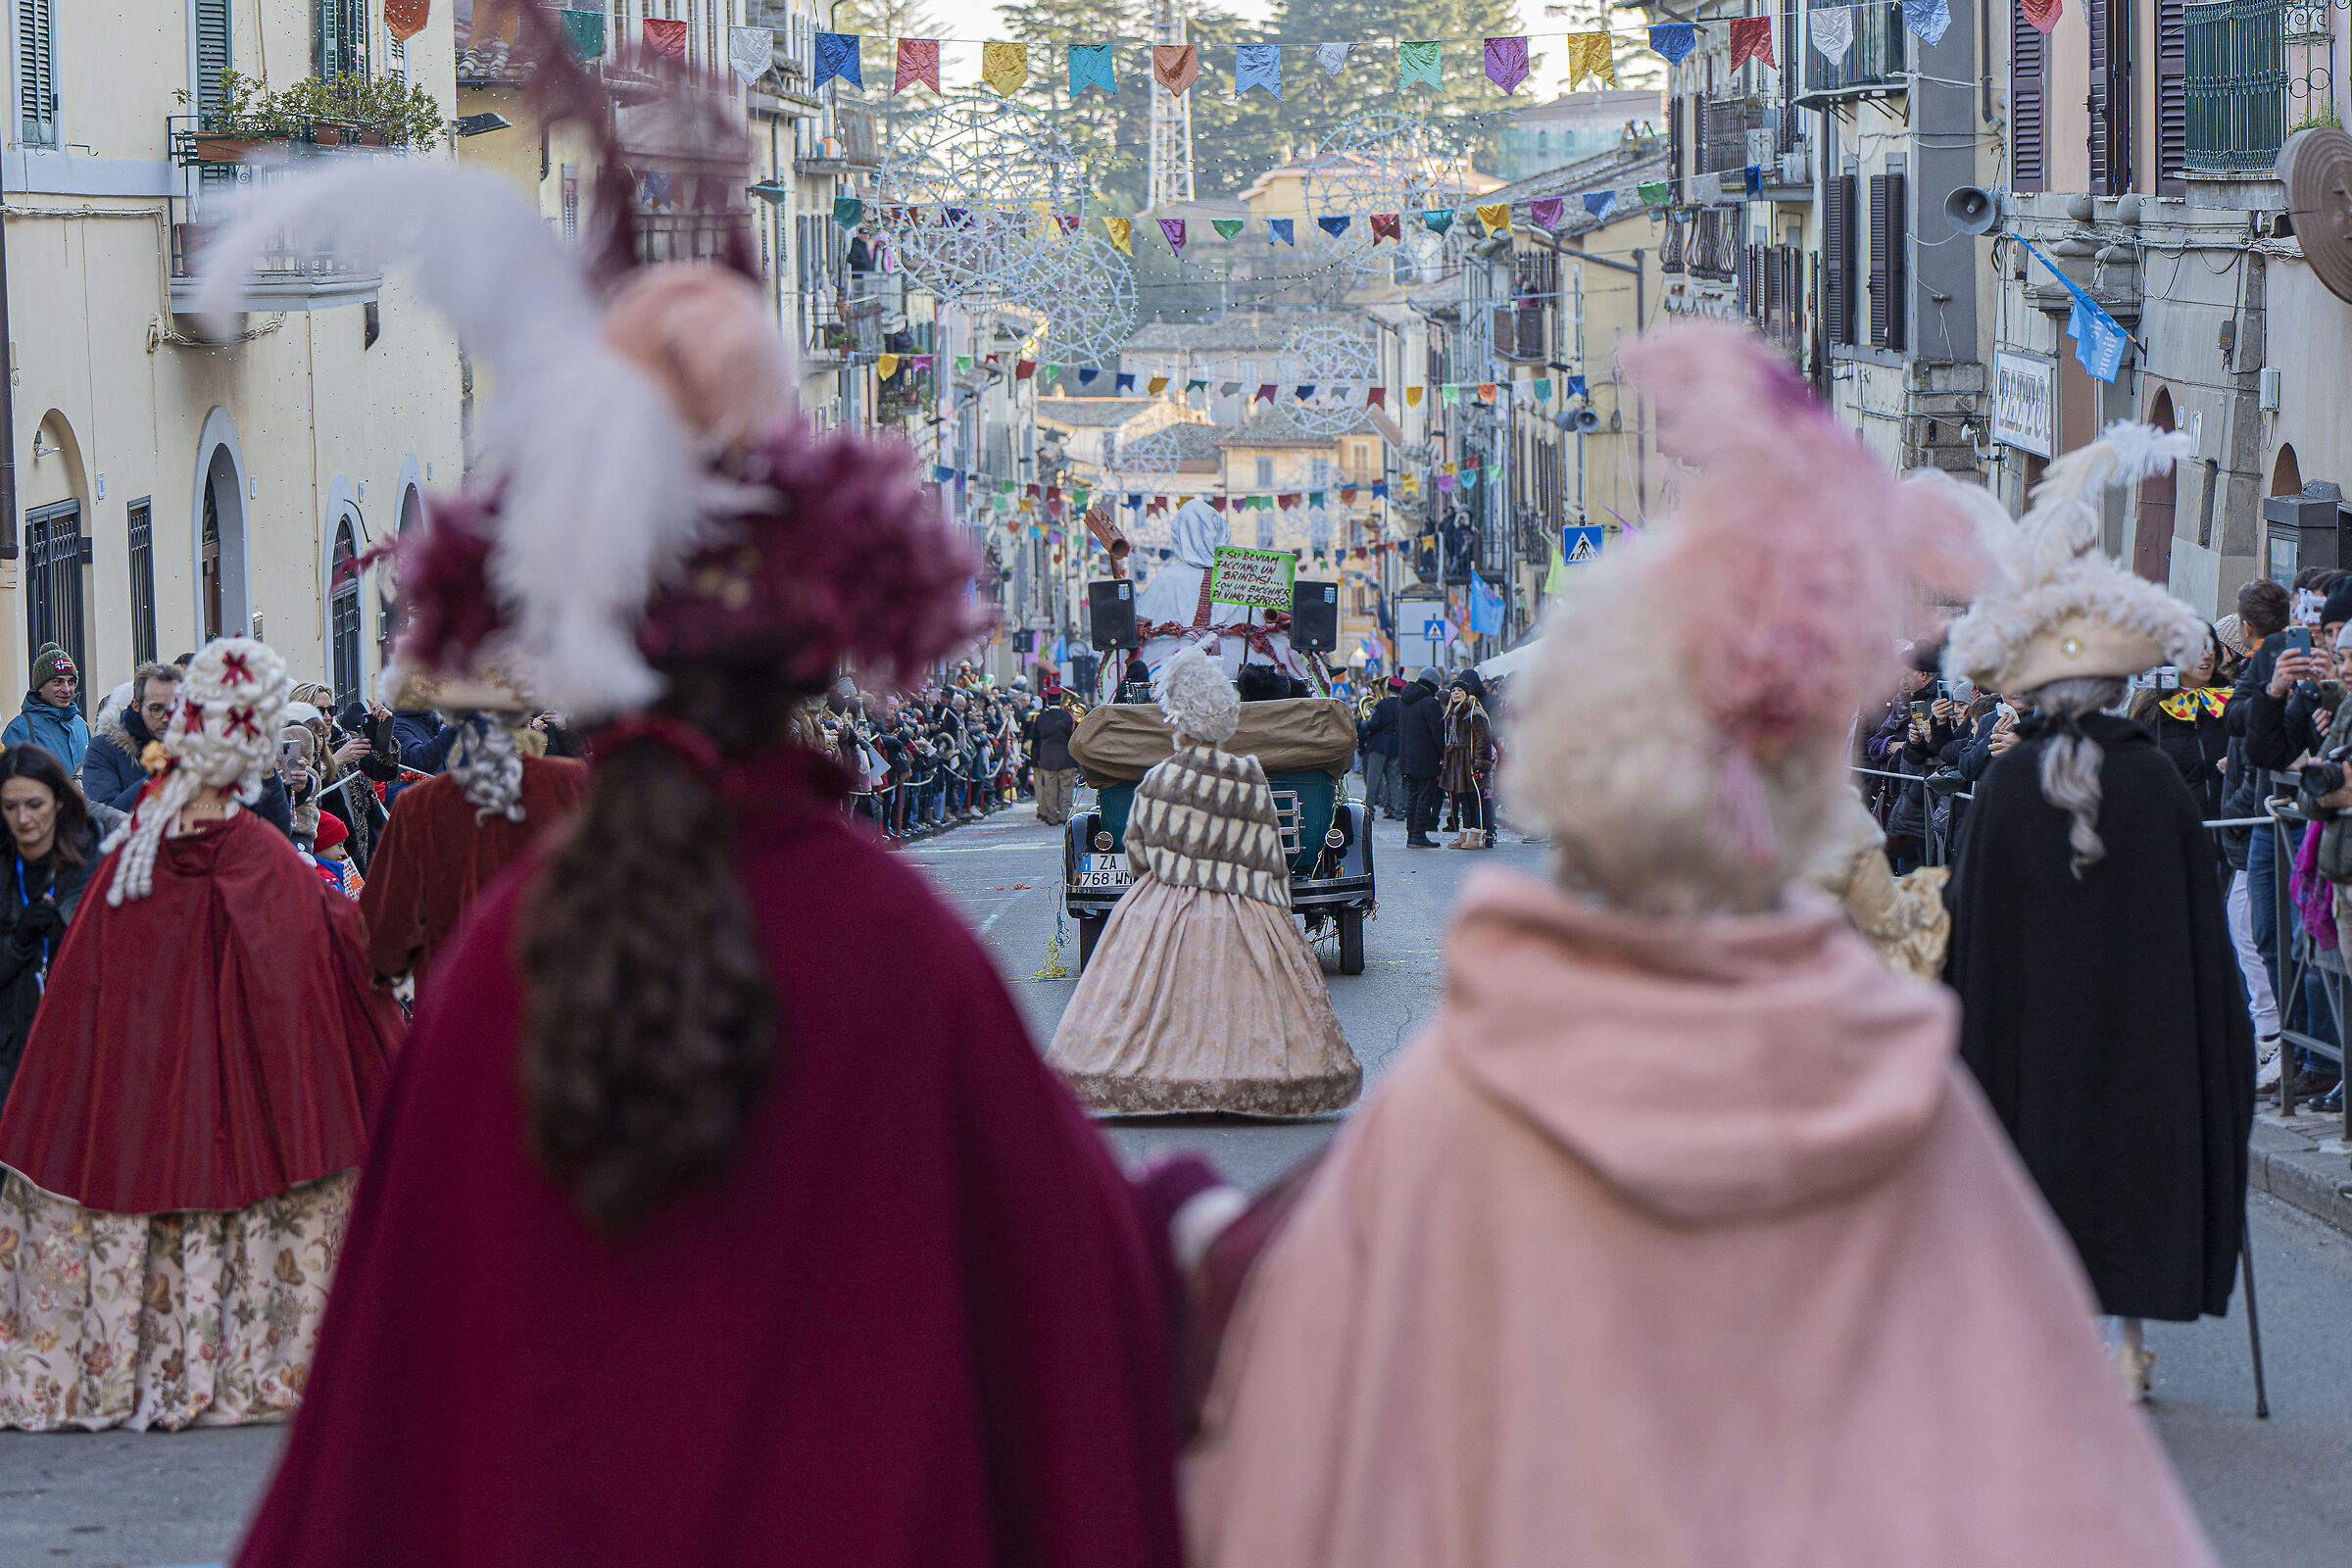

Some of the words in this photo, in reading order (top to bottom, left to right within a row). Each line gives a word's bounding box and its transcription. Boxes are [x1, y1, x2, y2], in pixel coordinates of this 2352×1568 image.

[1226, 550, 1241, 560] SU
[1242, 552, 1279, 565] BEVIAM
[1216, 561, 1257, 573] FACCIAMO
[1260, 565, 1277, 575] UN
[1223, 590, 1245, 602] VINO
[1248, 585, 1292, 599] BICCHIER
[1100, 856, 1117, 870] ZA
